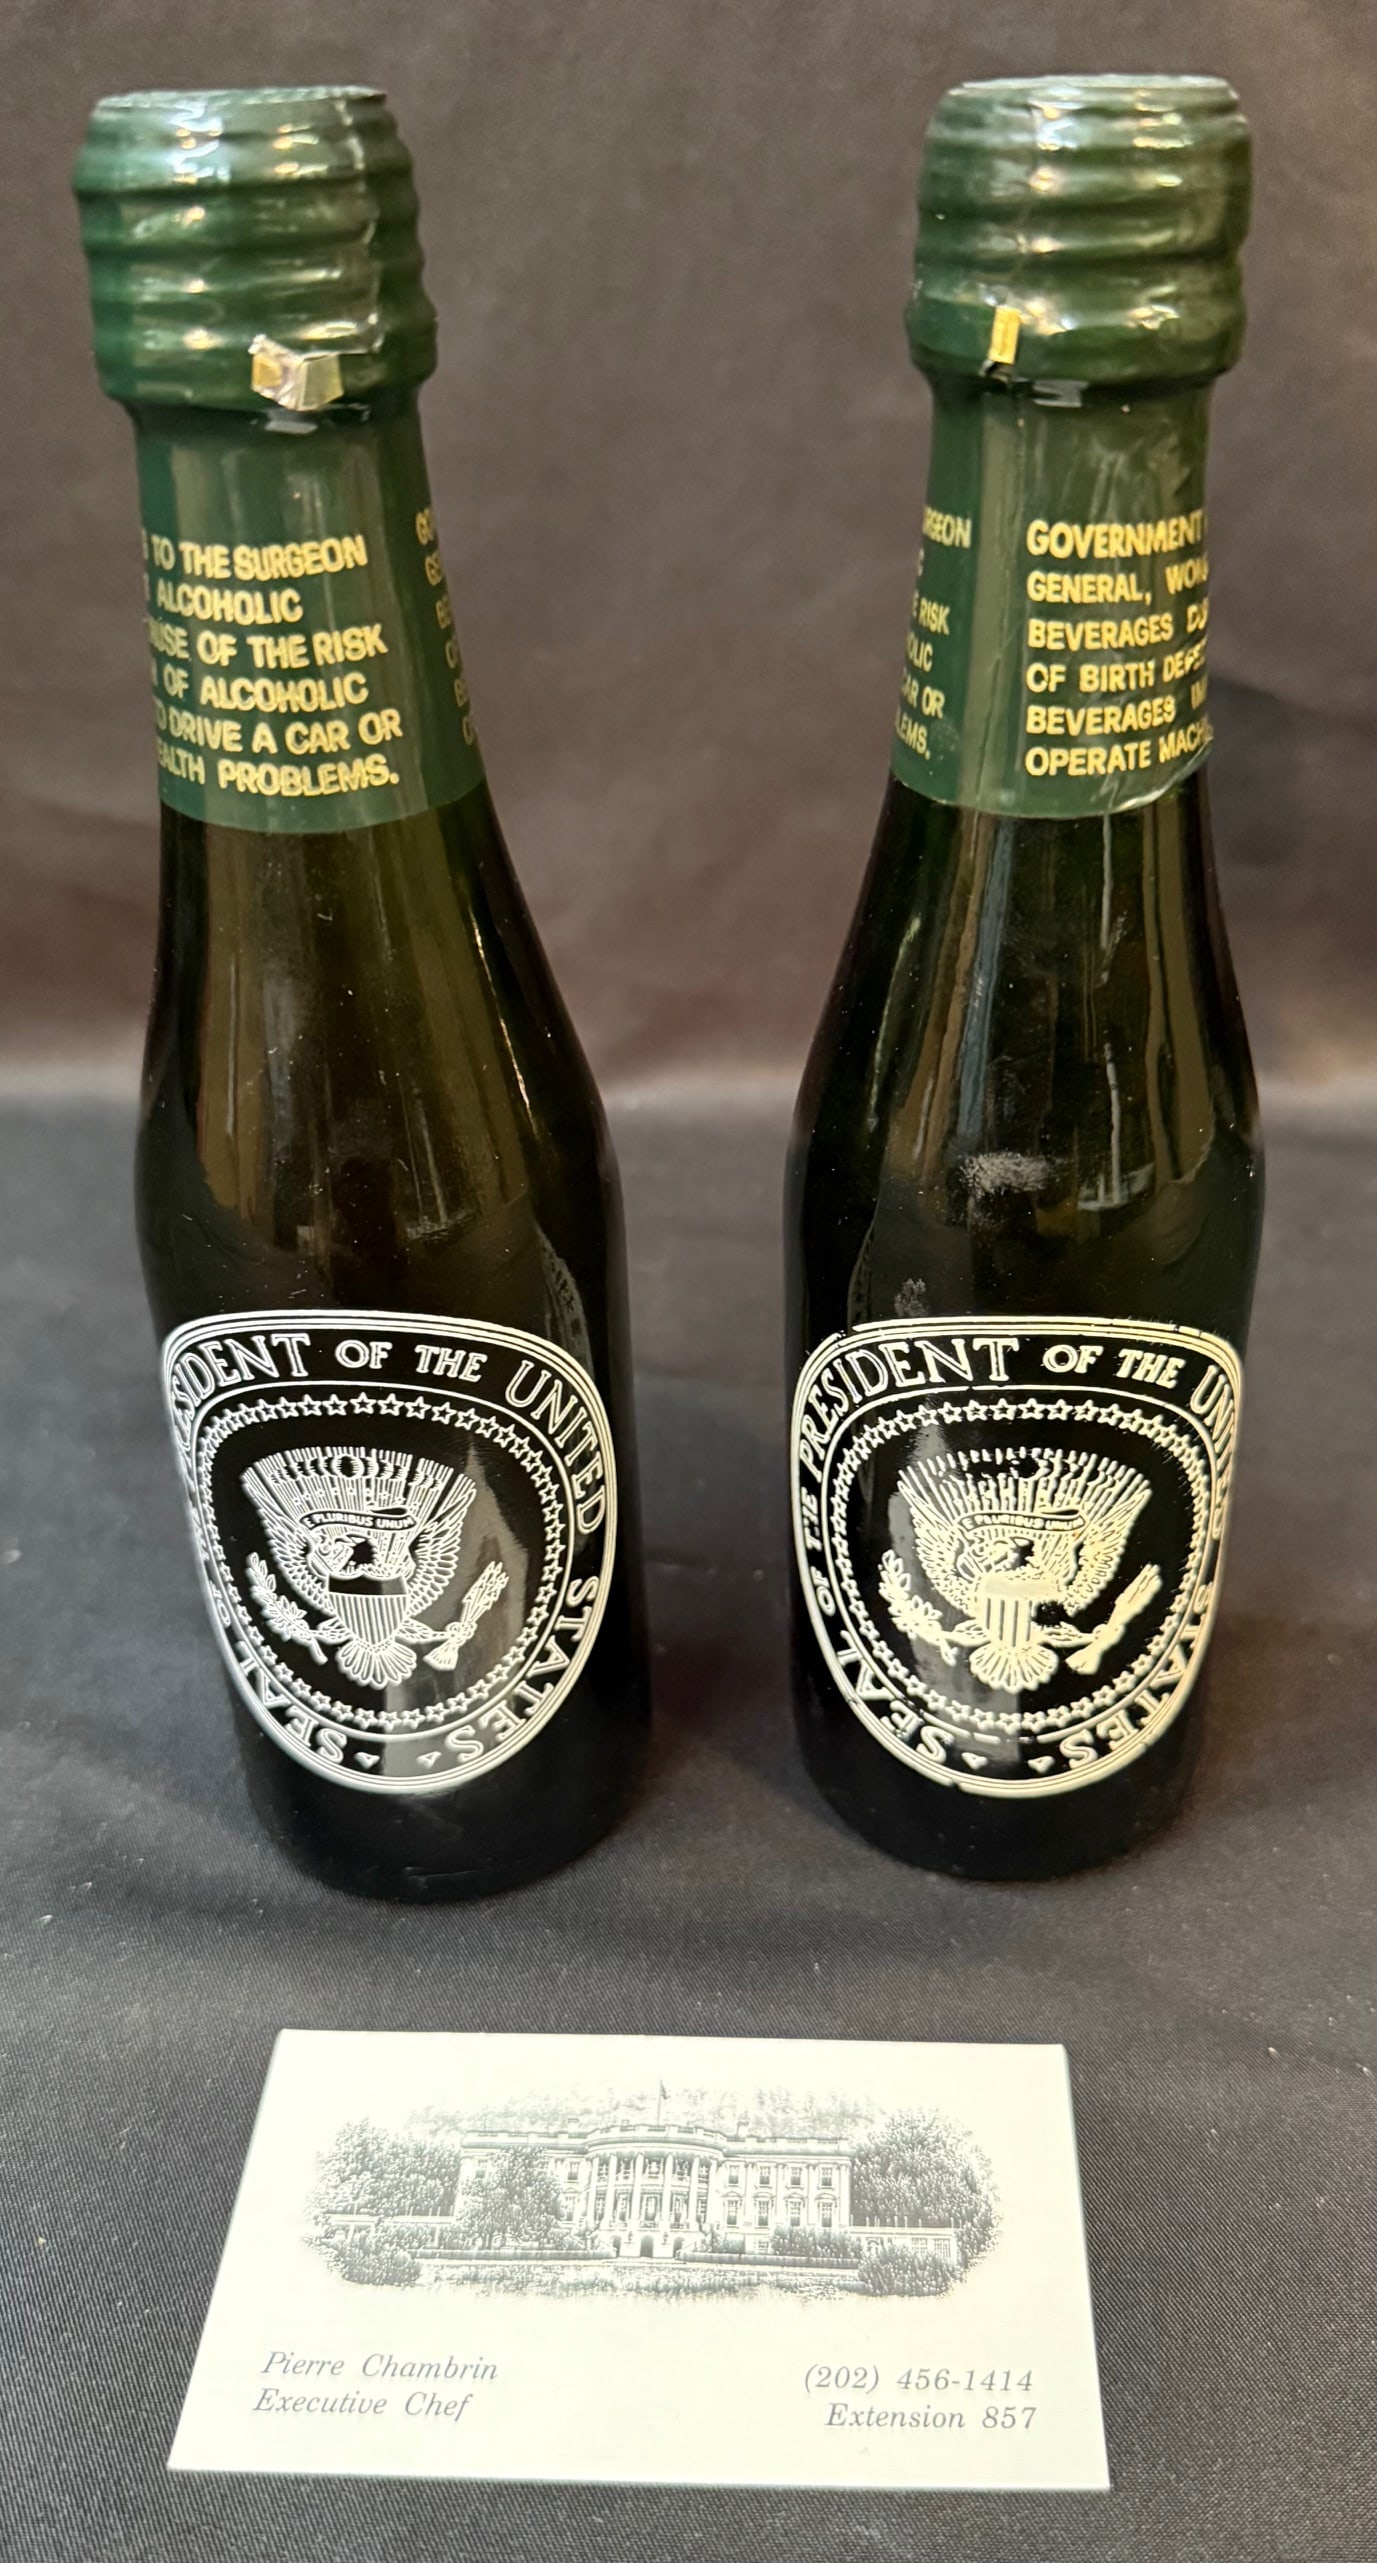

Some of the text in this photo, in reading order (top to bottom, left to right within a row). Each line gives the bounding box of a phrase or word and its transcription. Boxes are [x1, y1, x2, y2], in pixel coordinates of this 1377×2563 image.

[151, 534, 175, 571] TO
[179, 541, 231, 579] THE
[233, 535, 369, 581] SURGEON
[156, 578, 304, 625] ALCOHOLIC
[1026, 570, 1152, 606] GENERAL,
[919, 597, 950, 635] RISK
[1027, 612, 1174, 651] BEVERAGES
[196, 630, 238, 667] OF
[247, 635, 310, 669] THE
[313, 624, 389, 666] RISK
[163, 663, 189, 698] OF
[200, 672, 369, 713] ALCOHOLIC
[1080, 659, 1155, 692] BIRTH
[922, 686, 945, 719] OR
[1026, 695, 1176, 736] BEVERAGES
[168, 705, 243, 752] DRIVE
[250, 723, 277, 755] A
[285, 720, 351, 755] CAR
[358, 708, 403, 745] OR
[217, 754, 400, 797] PROBLEMS.
[1025, 739, 1151, 776] OPERATE
[335, 1339, 393, 1369] OF
[415, 1345, 487, 1382] THE
[801, 1337, 1021, 1478] PRESIDENT
[1042, 1344, 1104, 1374] OF
[1118, 1348, 1187, 1389] THE
[505, 1360, 607, 1534] UNITED
[303, 1512, 415, 1530] E PLURIBUS UNUM
[446, 1576, 601, 1763] STATES
[261, 2350, 499, 2380] Pierre Chambrin
[804, 2363, 1033, 2394] (202) 456-1414
[252, 2388, 474, 2422] Executive Chef
[825, 2402, 1037, 2429] Extension 857
